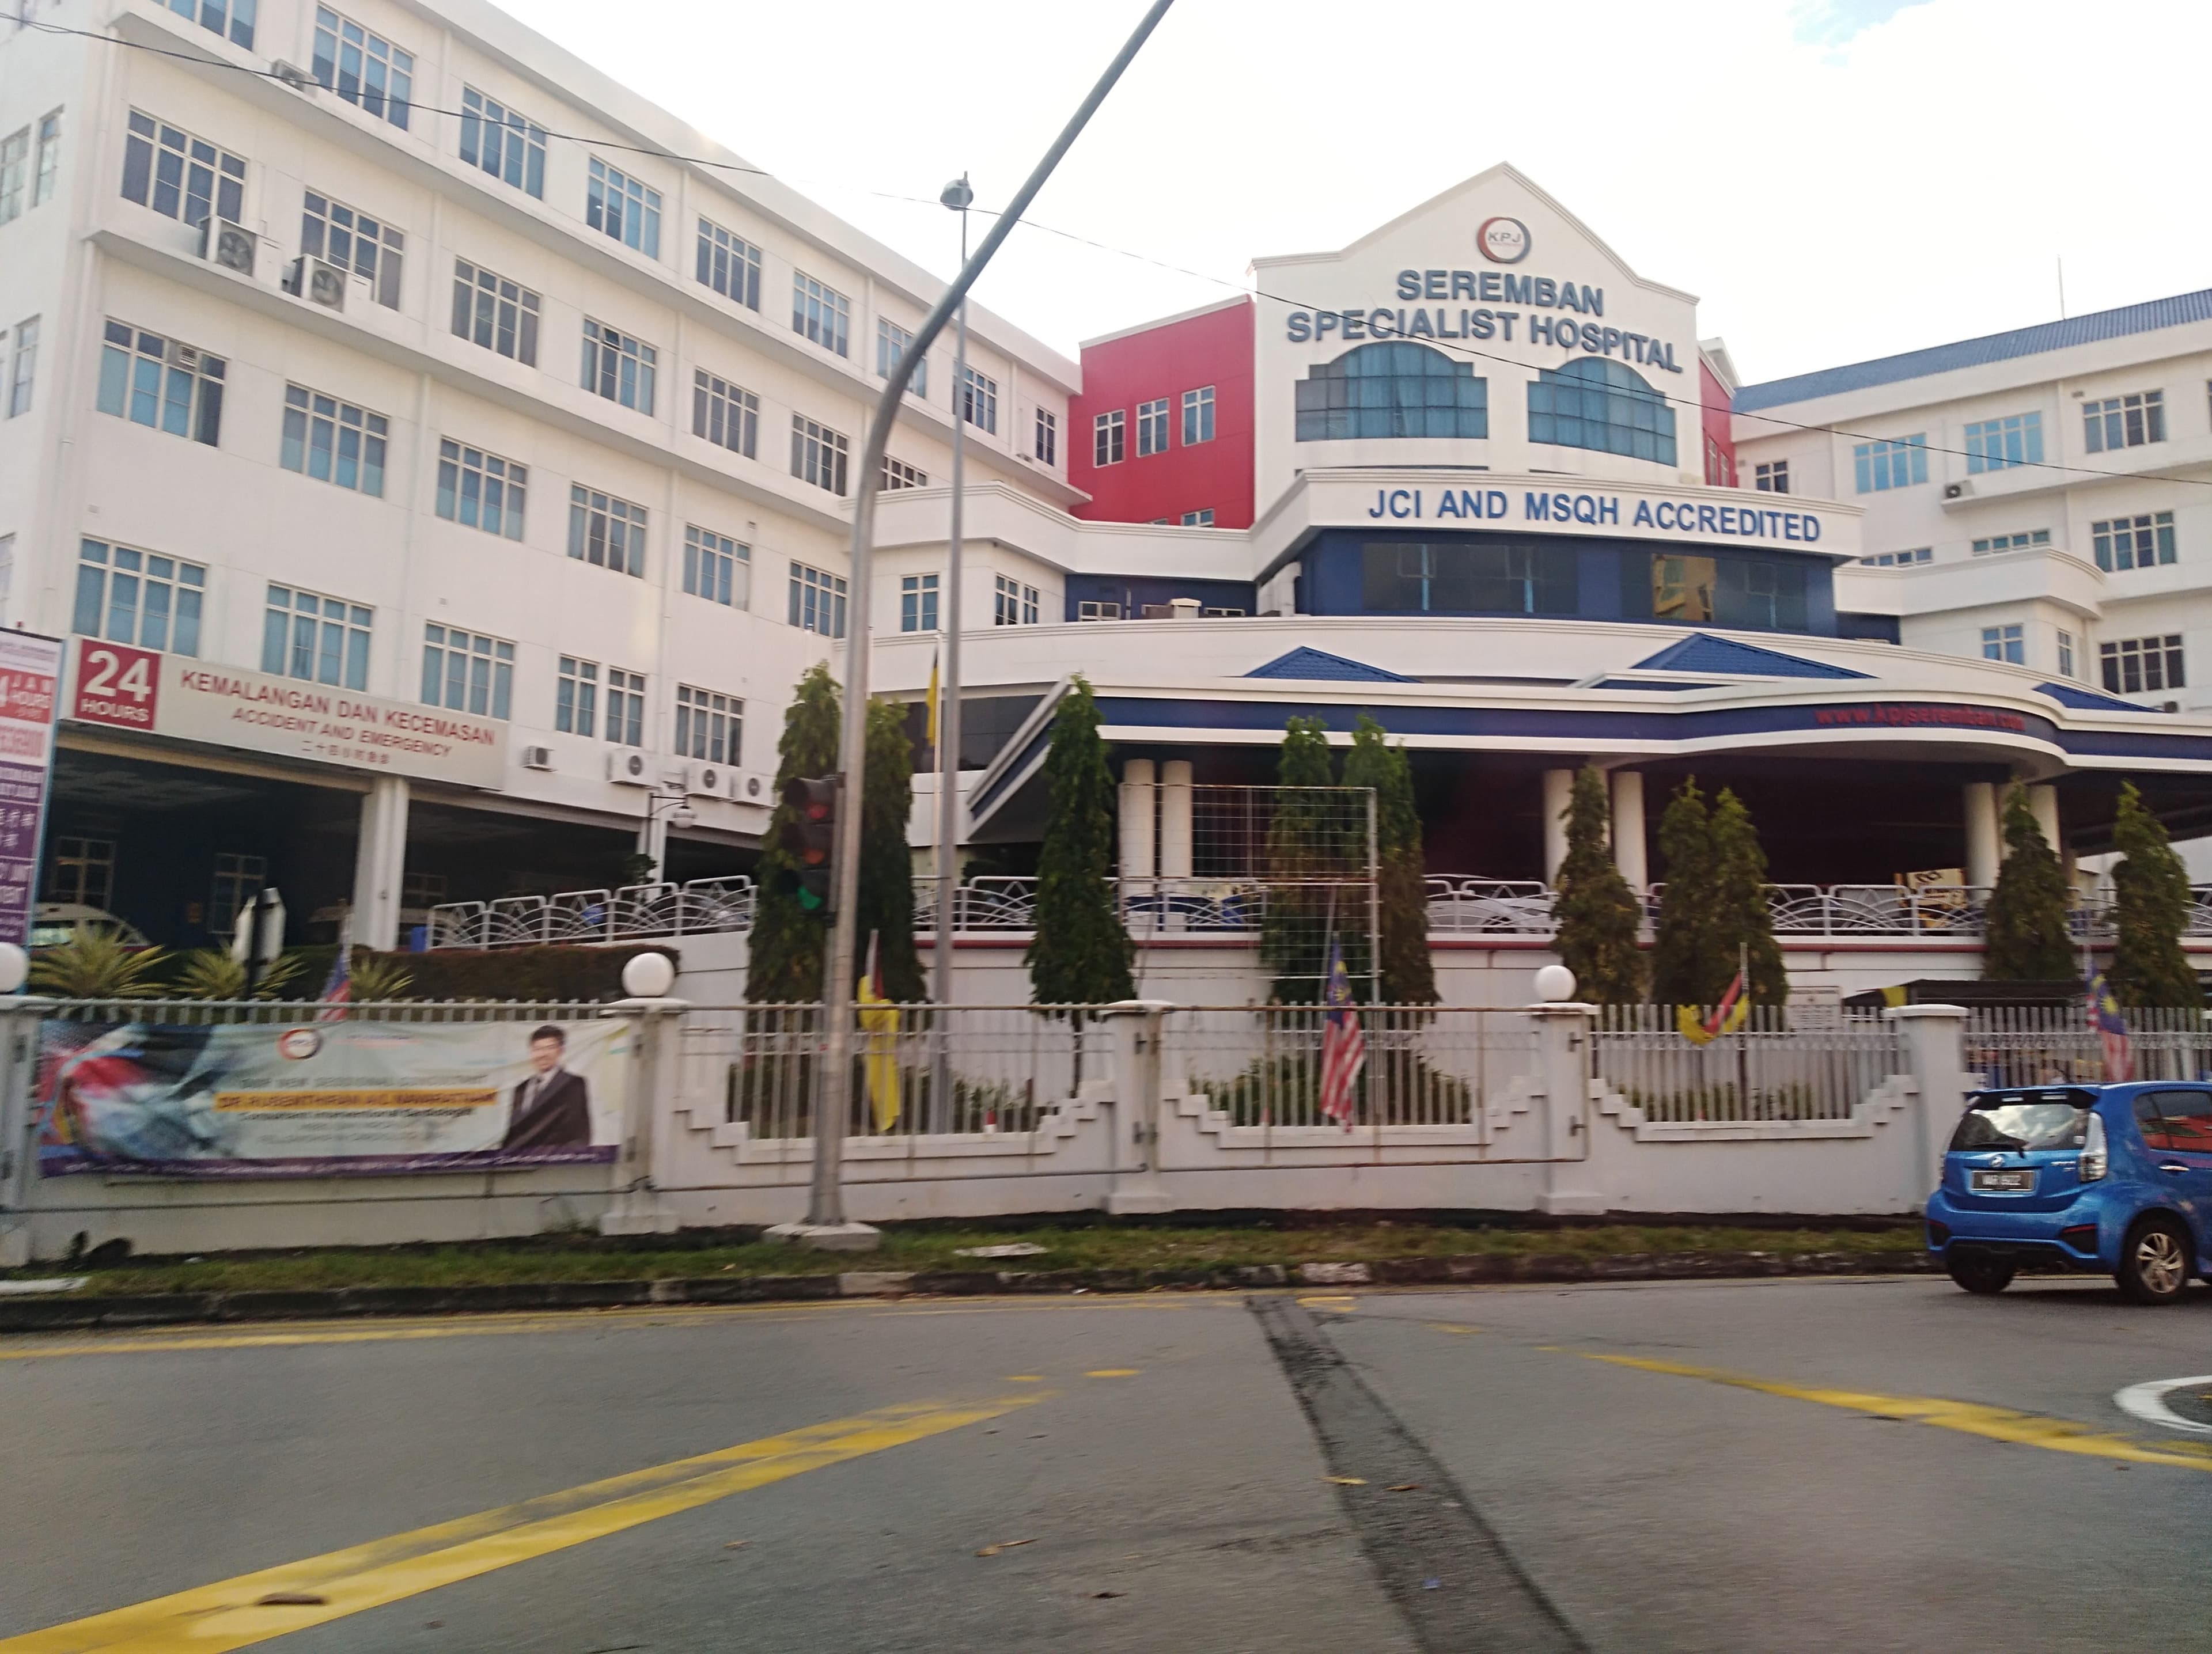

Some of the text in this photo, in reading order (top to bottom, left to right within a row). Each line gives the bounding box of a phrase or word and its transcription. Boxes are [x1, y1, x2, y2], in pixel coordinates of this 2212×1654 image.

[1488, 232, 1521, 242] KPJ
[1397, 269, 1603, 317] SEREMBAN
[1287, 308, 1683, 374] SPECIALIST HOSPITAL
[1369, 490, 1820, 543] JCI AND MSQH ACCREDITED
[84, 650, 151, 701] 24
[81, 700, 149, 722] HOURS
[181, 670, 494, 745] KEMALANGAN DAN KECEMASAN
[232, 708, 452, 757] ACCIDENT AND EMERGENCY
